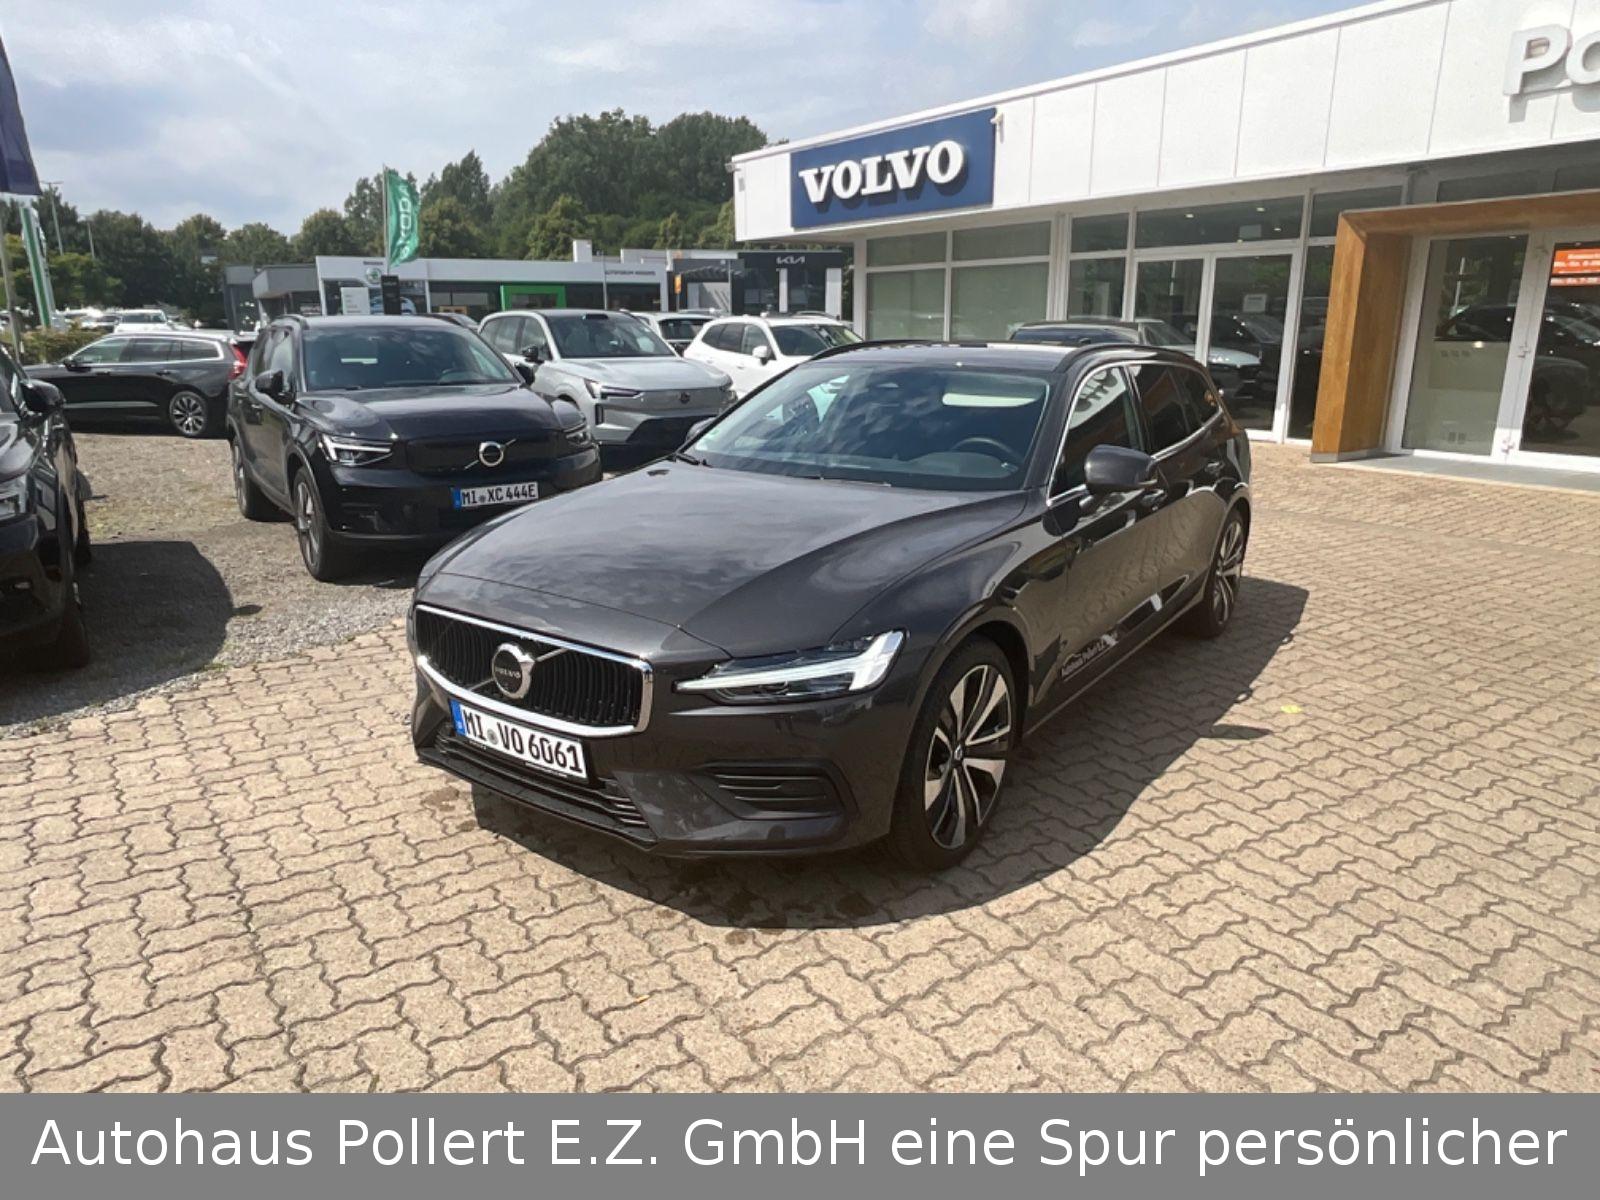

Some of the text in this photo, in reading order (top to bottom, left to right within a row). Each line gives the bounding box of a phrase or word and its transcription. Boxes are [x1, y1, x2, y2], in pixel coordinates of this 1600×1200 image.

[799, 140, 964, 203] VOLVO
[462, 484, 536, 505] MI XC 444E
[494, 666, 521, 679] LVO
[463, 710, 487, 742] MI
[497, 722, 525, 755] VO
[528, 734, 583, 774] 6061
